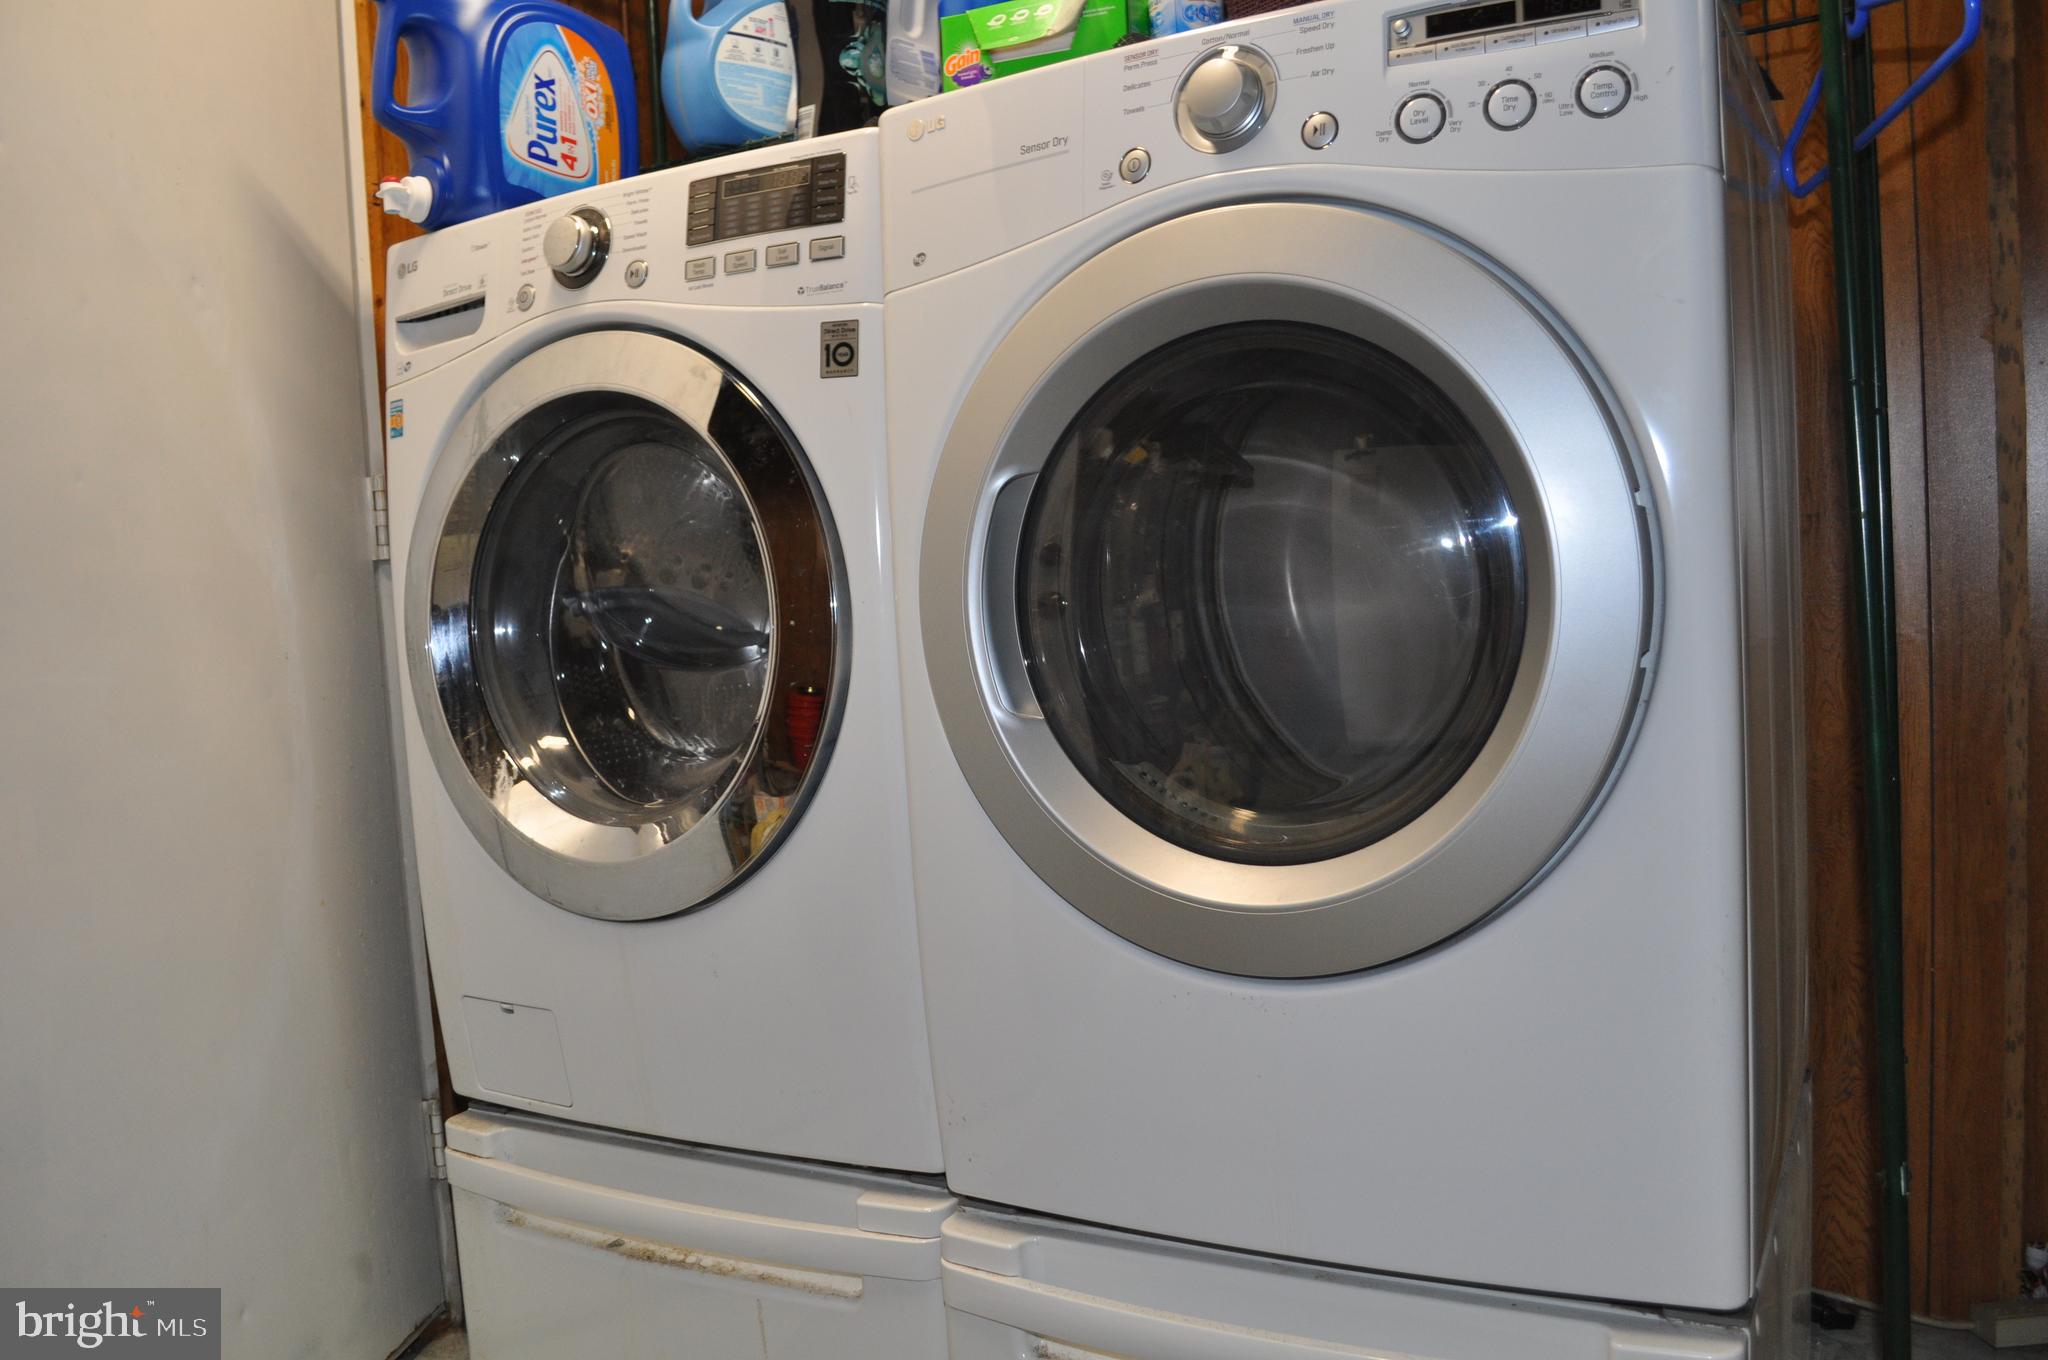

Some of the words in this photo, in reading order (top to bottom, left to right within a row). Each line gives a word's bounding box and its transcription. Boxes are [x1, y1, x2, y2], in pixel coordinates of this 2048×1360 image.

[1322, 10, 1335, 19] DRY
[1299, 24, 1320, 34] Speed
[1323, 22, 1335, 30] Dry
[944, 48, 981, 77] Gain
[1322, 68, 1335, 76] Dry
[1408, 80, 1430, 88] Normal
[1502, 96, 1519, 104] Time
[1590, 90, 1618, 99] Control
[527, 73, 558, 167] Purex
[1413, 110, 1425, 118] Dry
[927, 117, 945, 133] LG
[1410, 118, 1429, 126] Level
[1019, 140, 1050, 156] Sensor
[1052, 135, 1069, 150] Dry
[560, 152, 577, 171] 4
[406, 261, 418, 274] LG
[824, 341, 855, 368] 10
